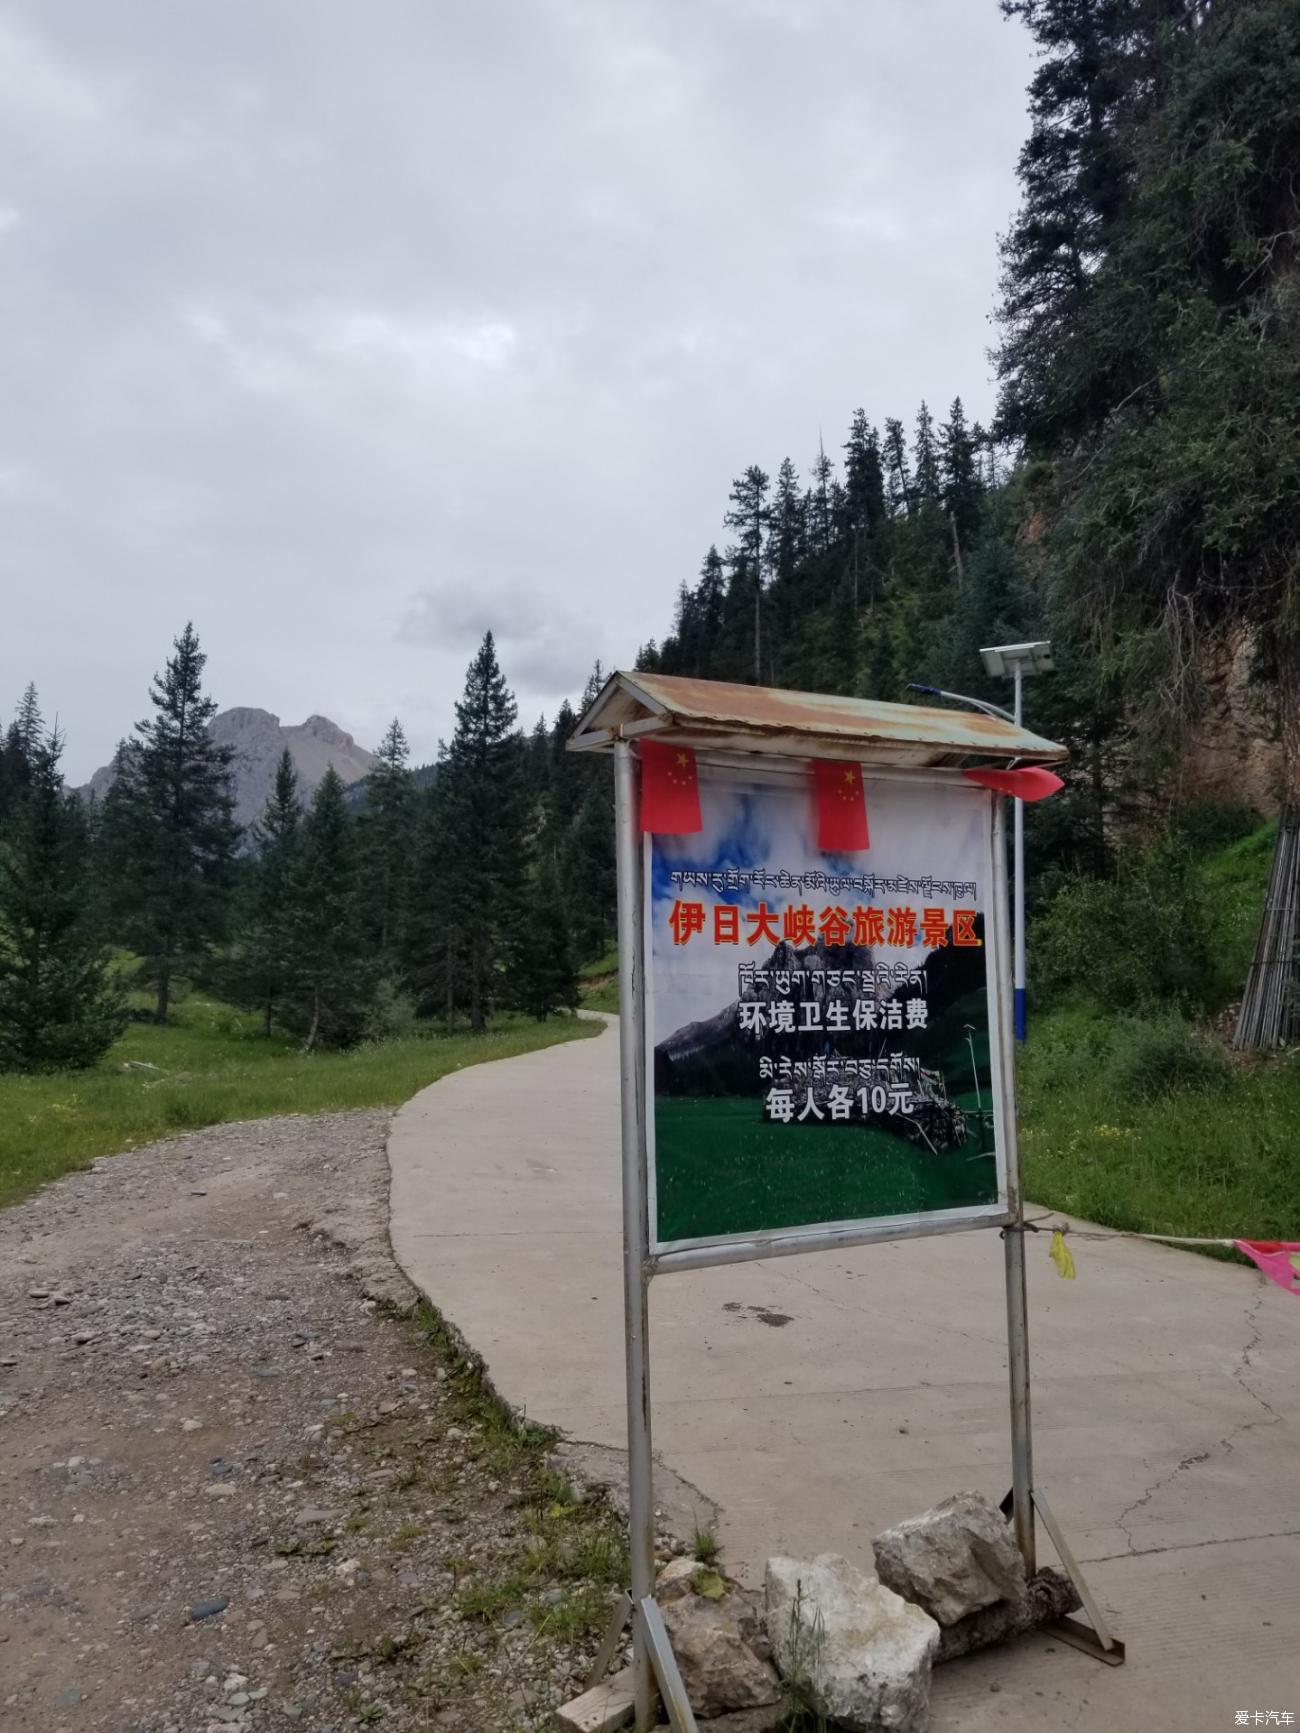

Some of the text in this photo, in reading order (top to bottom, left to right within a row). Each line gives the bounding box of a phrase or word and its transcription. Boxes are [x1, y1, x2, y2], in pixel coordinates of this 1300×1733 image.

[670, 898, 983, 948] 伊日大峡谷旅游景区
[738, 998, 929, 1033] 环境卫生保洁费
[765, 1082, 915, 1123] 每人各10元
